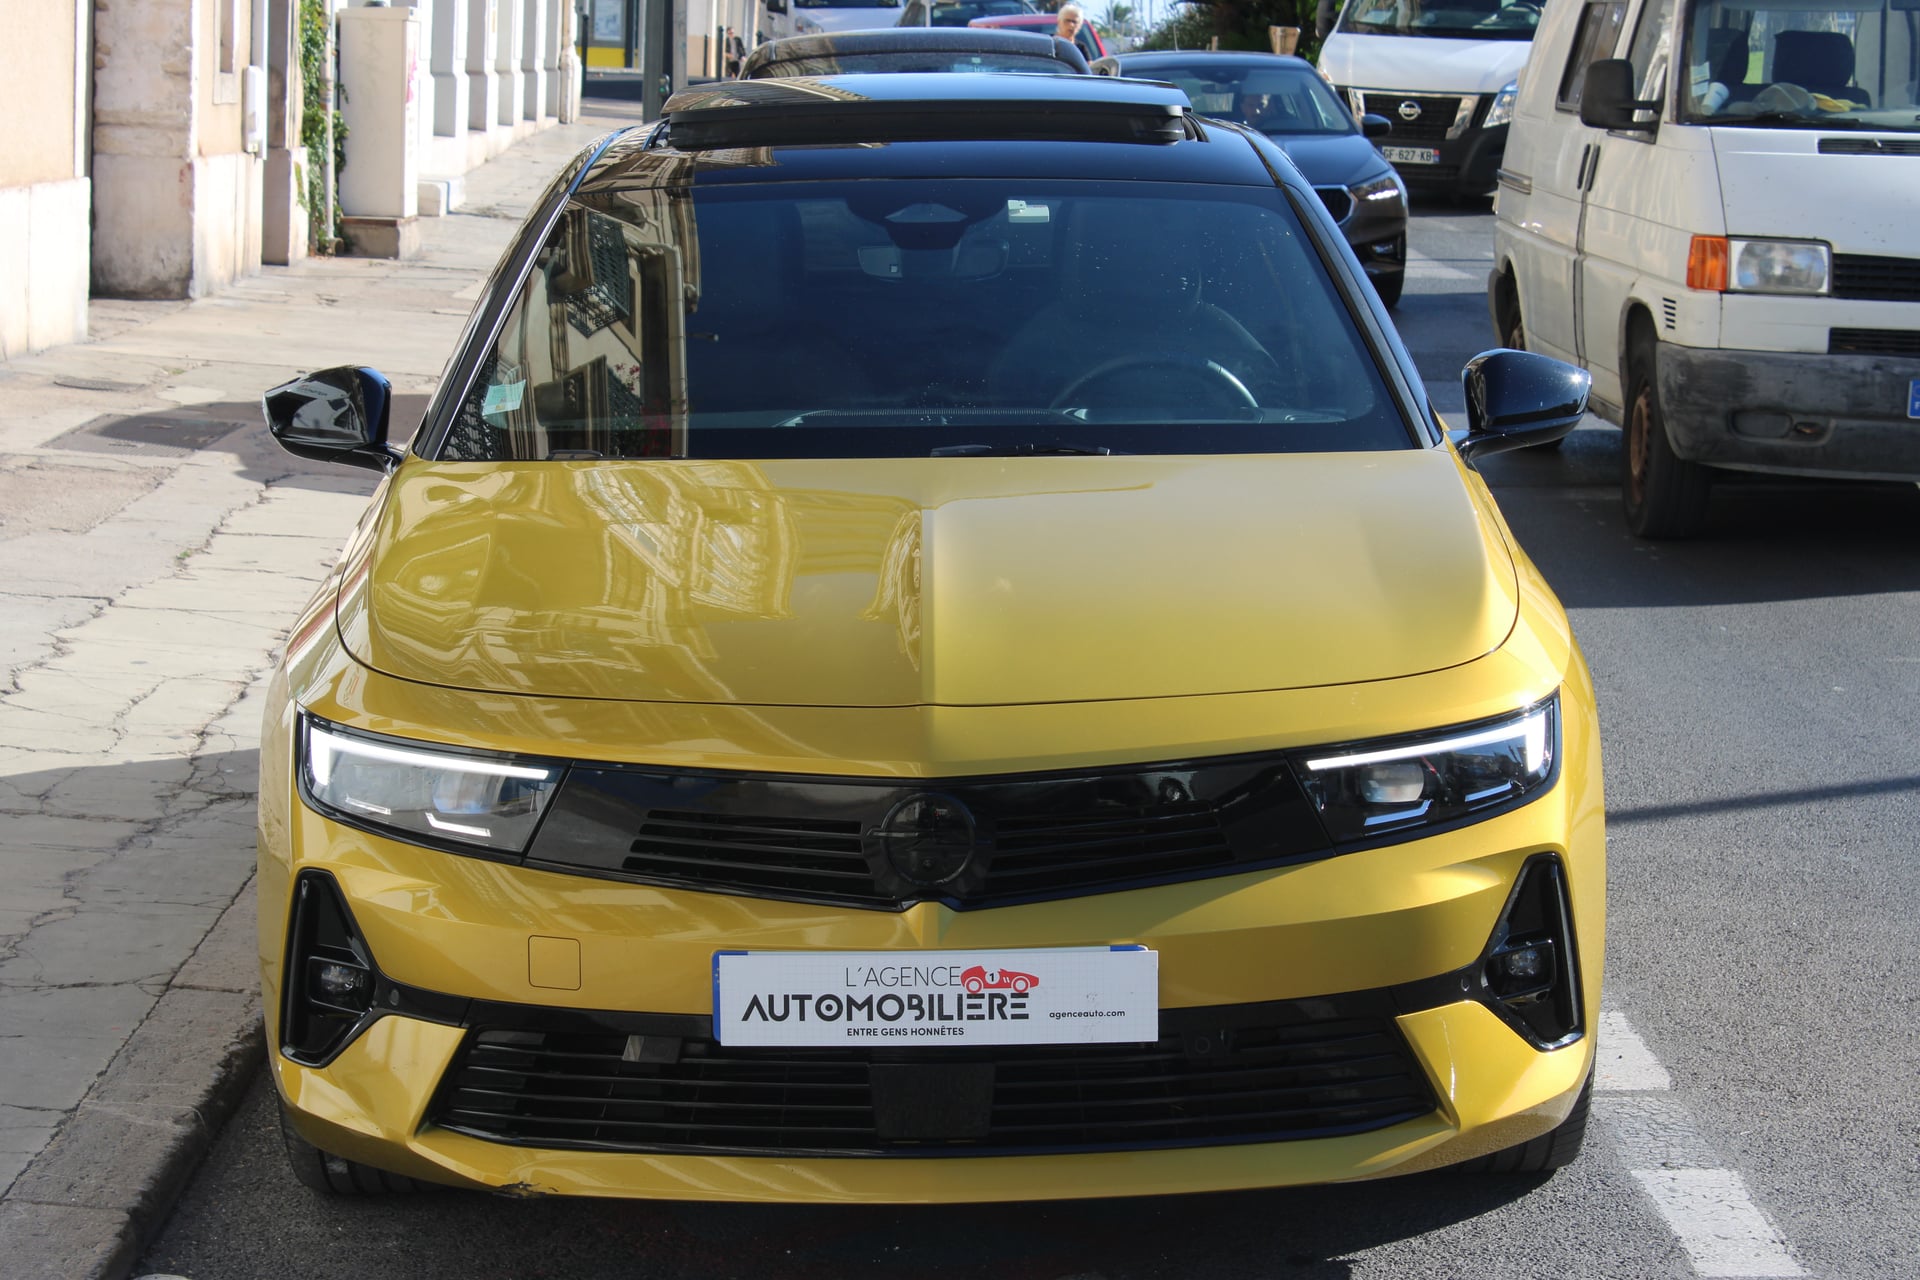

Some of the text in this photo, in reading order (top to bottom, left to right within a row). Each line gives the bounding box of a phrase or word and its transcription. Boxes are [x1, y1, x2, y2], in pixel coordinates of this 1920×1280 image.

[845, 966, 961, 987] L'AGENCE
[989, 972, 995, 982] 1
[1049, 1009, 1126, 1019] agenceauto.com
[847, 1025, 964, 1036] ENTRE GENS HONNÊTES
